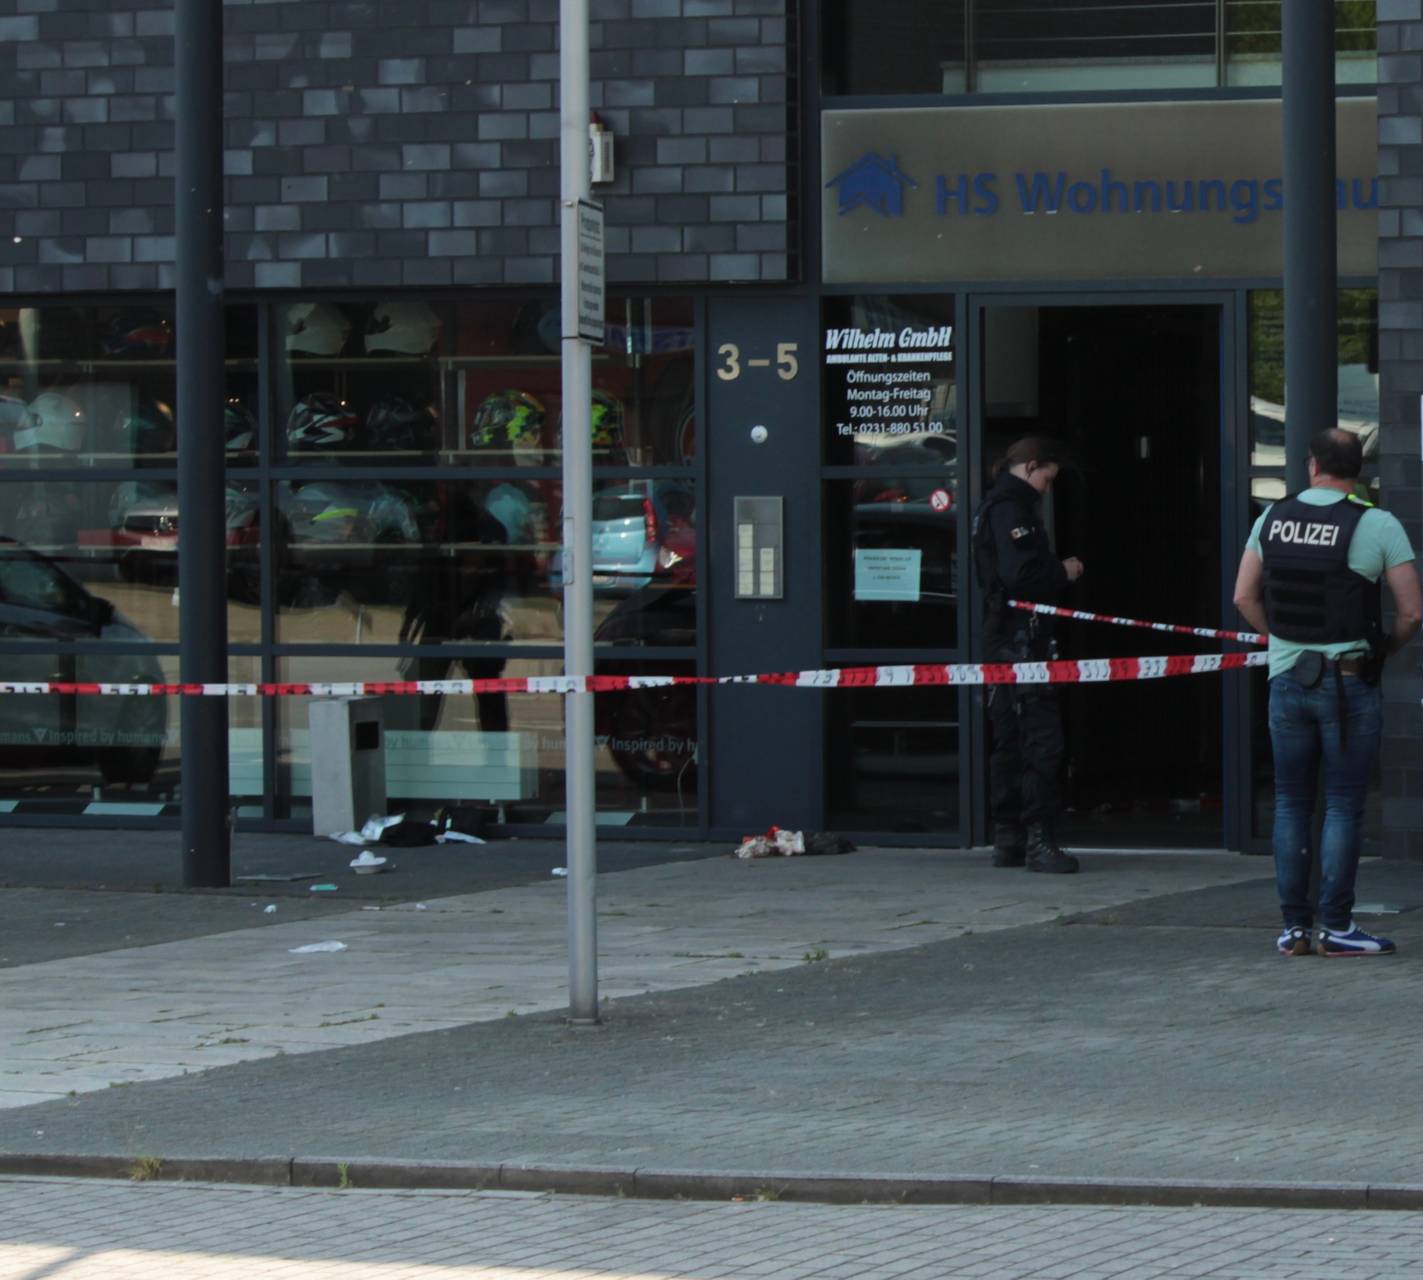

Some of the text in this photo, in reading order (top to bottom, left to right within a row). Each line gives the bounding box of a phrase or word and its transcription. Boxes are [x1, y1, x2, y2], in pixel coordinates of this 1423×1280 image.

[936, 172, 998, 216] HS
[825, 326, 953, 350] Wilhelm GmbH
[846, 369, 931, 385] Öffnungszeiten
[846, 387, 931, 403] Montag-Freitag
[849, 405, 929, 417] 9.00-16.00 Uhr
[860, 422, 911, 434] 0231-880
[913, 422, 925, 433] 51
[928, 422, 943, 433] 00
[1268, 520, 1340, 546] POLIZEI
[611, 738, 664, 753] Inspired
[667, 737, 684, 754] by
